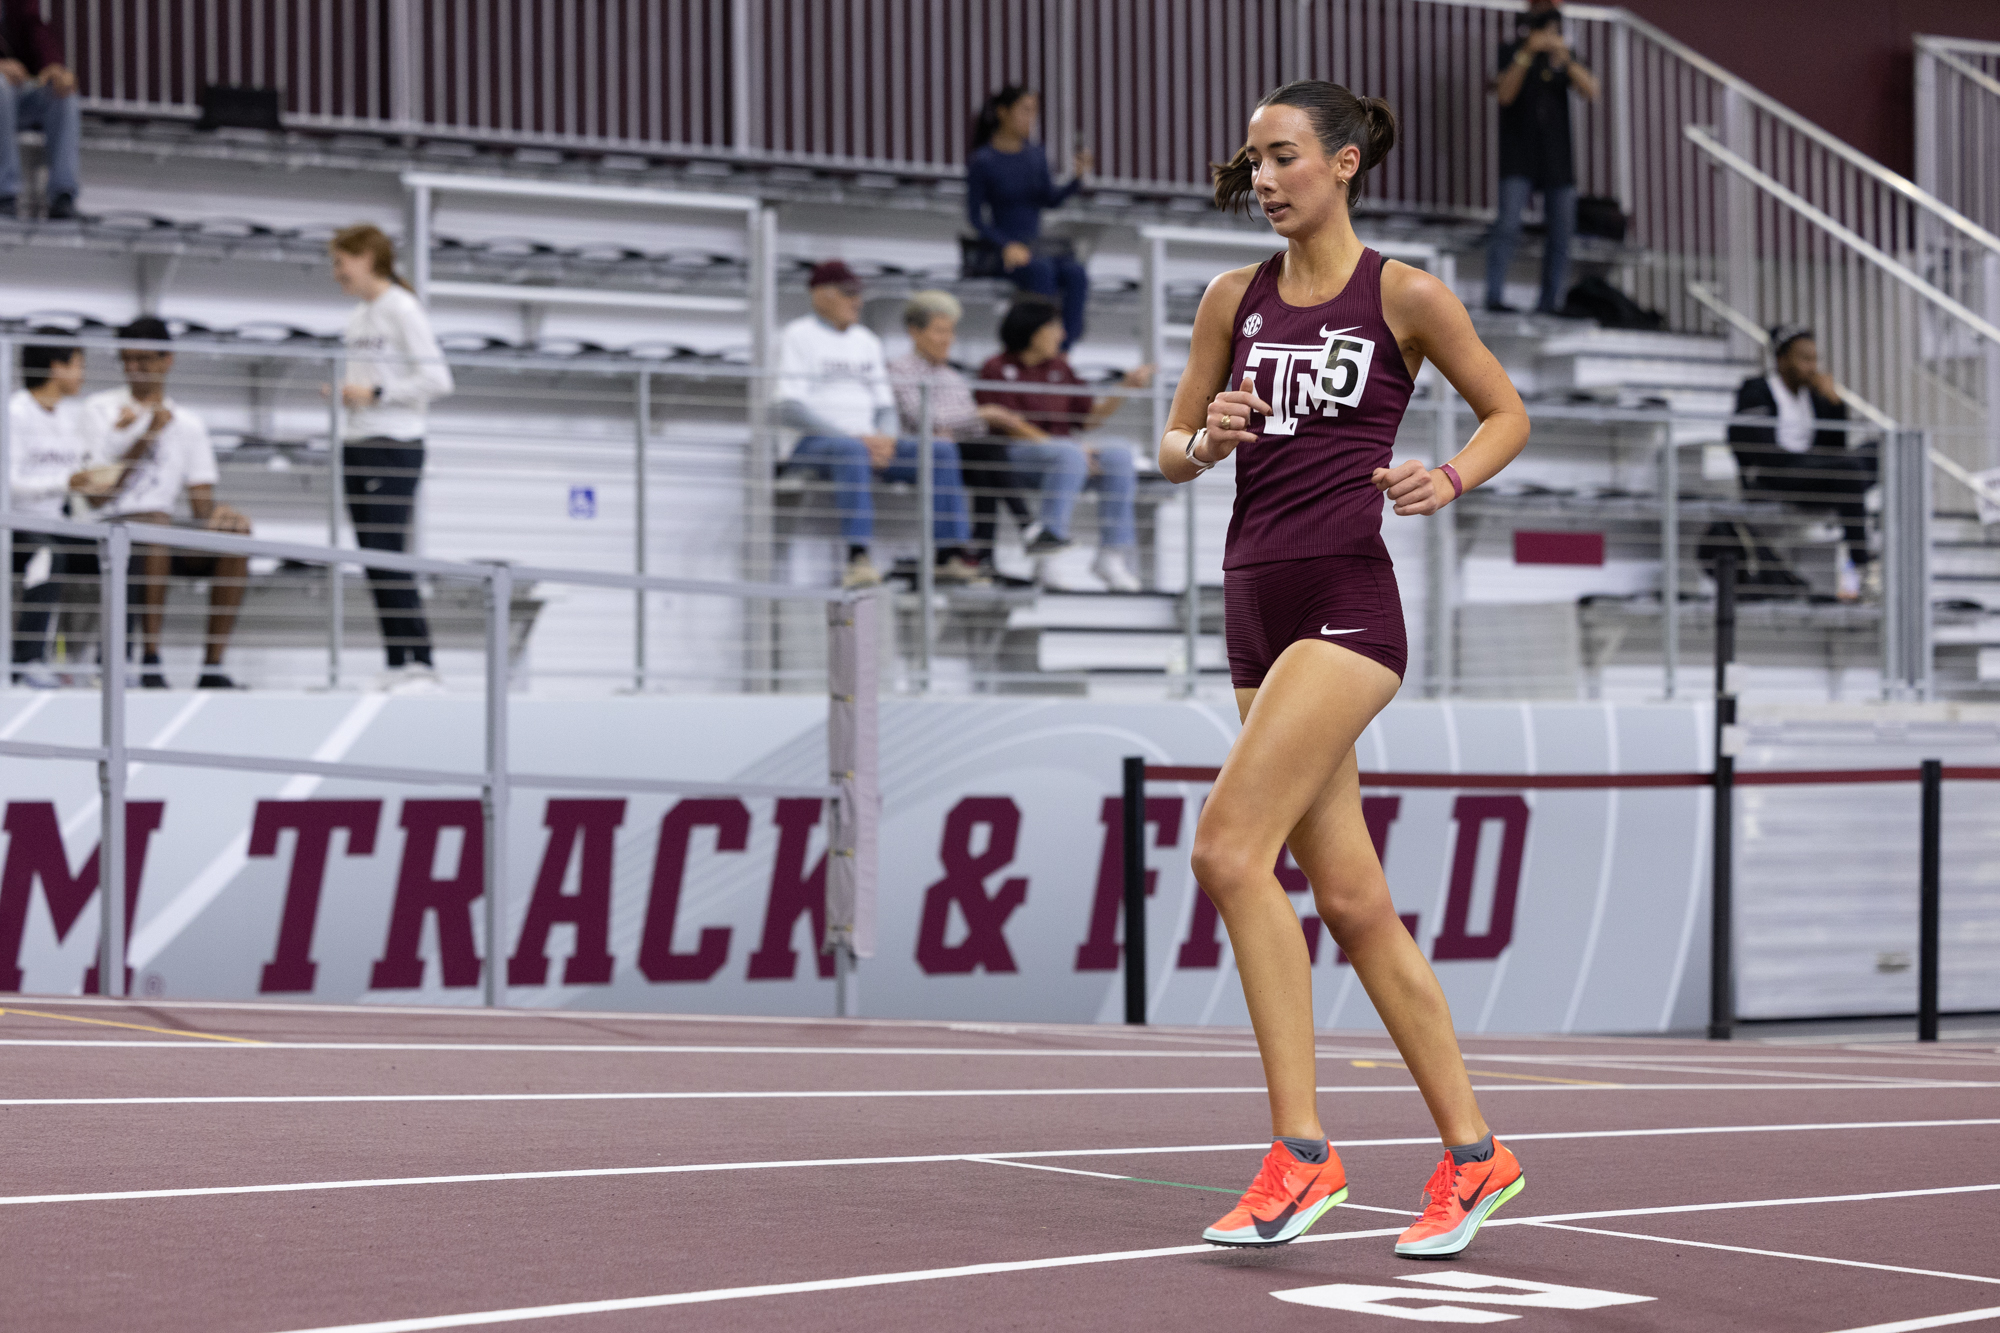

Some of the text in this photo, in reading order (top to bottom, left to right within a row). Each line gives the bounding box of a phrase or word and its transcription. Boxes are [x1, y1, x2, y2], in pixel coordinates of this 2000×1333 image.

[1243, 314, 1261, 336] SEC
[1321, 339, 1363, 398] 5
[248, 797, 837, 994] TRACK
[915, 795, 1028, 977] &
